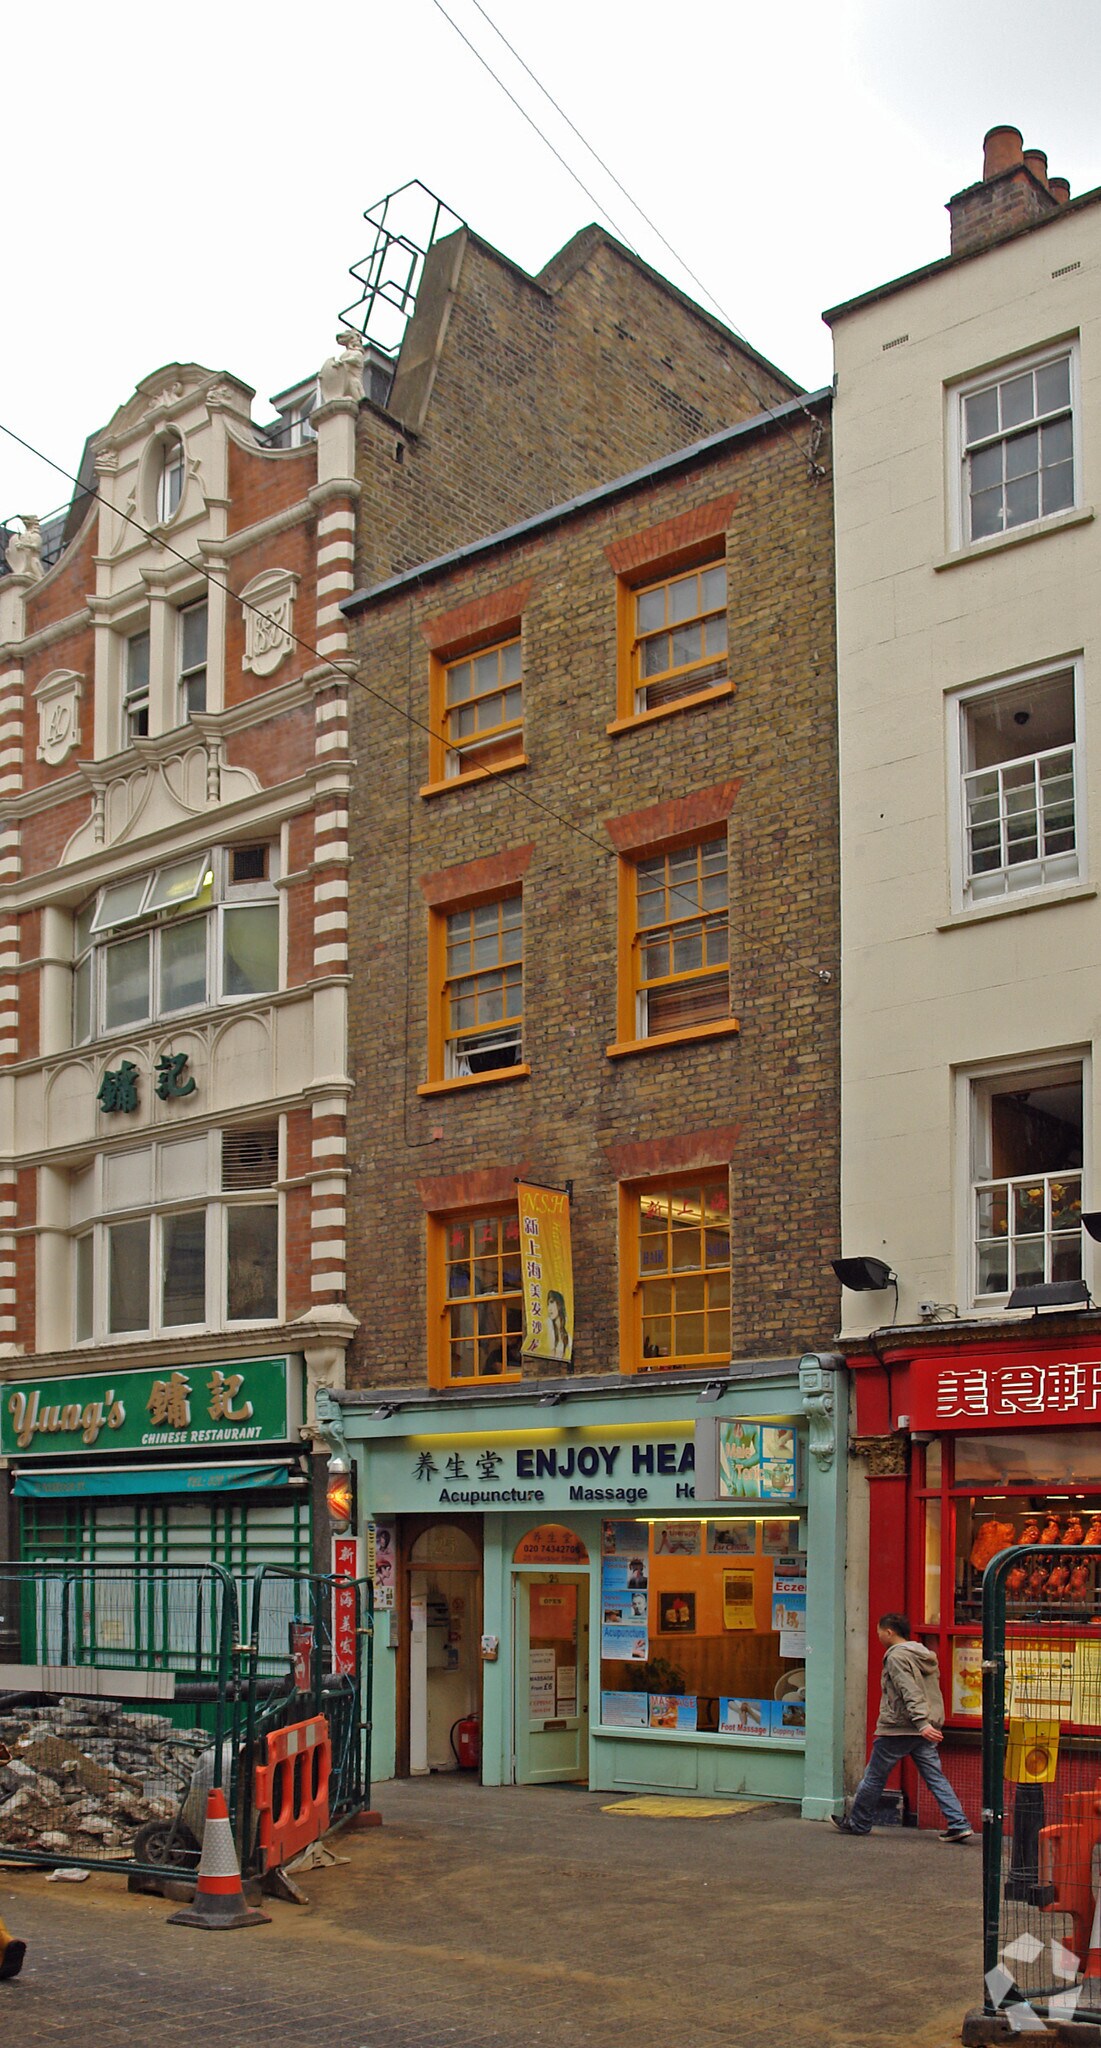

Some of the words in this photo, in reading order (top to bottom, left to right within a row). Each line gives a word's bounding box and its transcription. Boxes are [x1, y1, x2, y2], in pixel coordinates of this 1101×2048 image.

[8, 1389, 126, 1448] Yung's
[141, 1430, 188, 1445] CHINESE
[190, 1426, 262, 1442] RESTAURANT
[411, 1451, 503, 1482] 养生堂
[516, 1445, 620, 1478] ENJOY
[439, 1488, 544, 1505] Acupuncture
[569, 1485, 648, 1503] Massage
[523, 1544, 539, 1553] 020
[775, 1582, 807, 1592] Ecze
[604, 1627, 646, 1640] Acupuncture
[651, 1695, 696, 1708] MASSAGE
[720, 1722, 737, 1732] Foot
